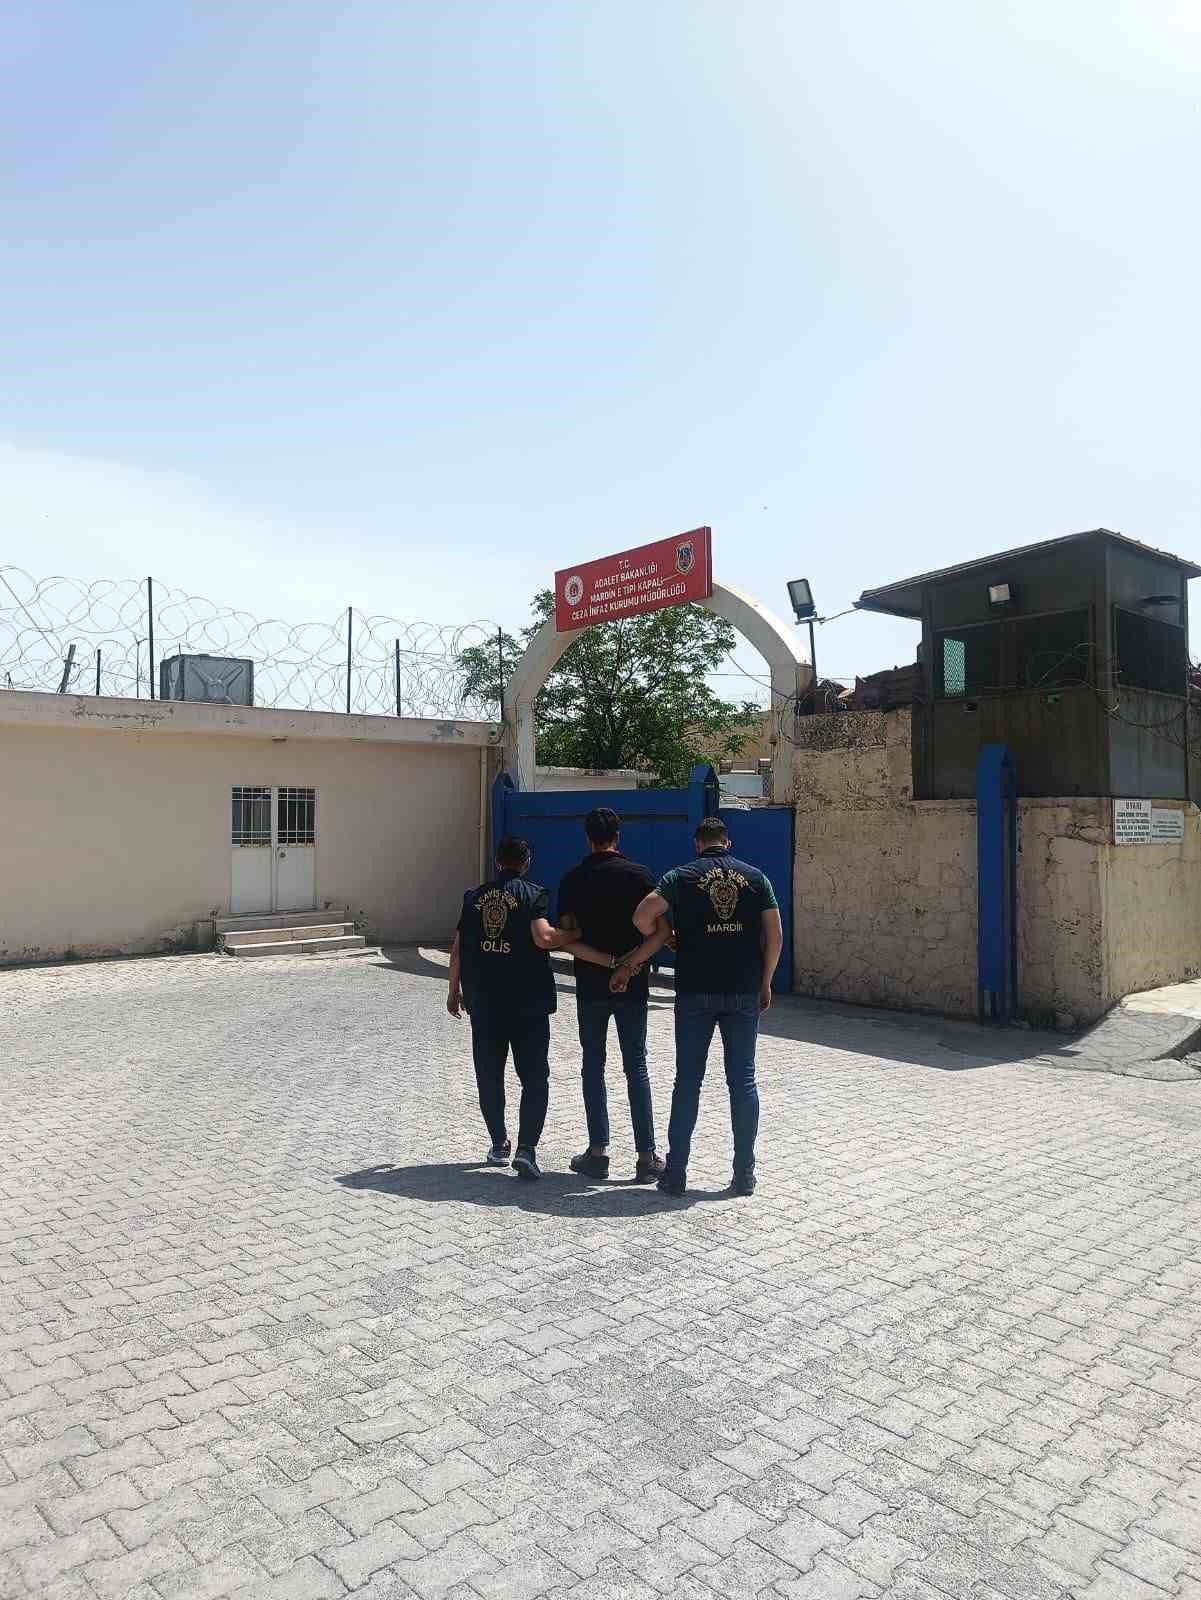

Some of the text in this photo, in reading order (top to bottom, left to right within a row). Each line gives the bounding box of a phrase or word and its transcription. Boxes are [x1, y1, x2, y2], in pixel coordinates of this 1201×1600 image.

[594, 563, 658, 590] ADALET BAKANLIĞI
[618, 559, 631, 570] T.C.
[571, 582, 686, 621] CEZA İNFAZ KURUMU MÜDÜRLÜĞÜ
[590, 576, 663, 603] MARDİN E TİPİ KAPALI
[480, 939, 511, 953] OLİS
